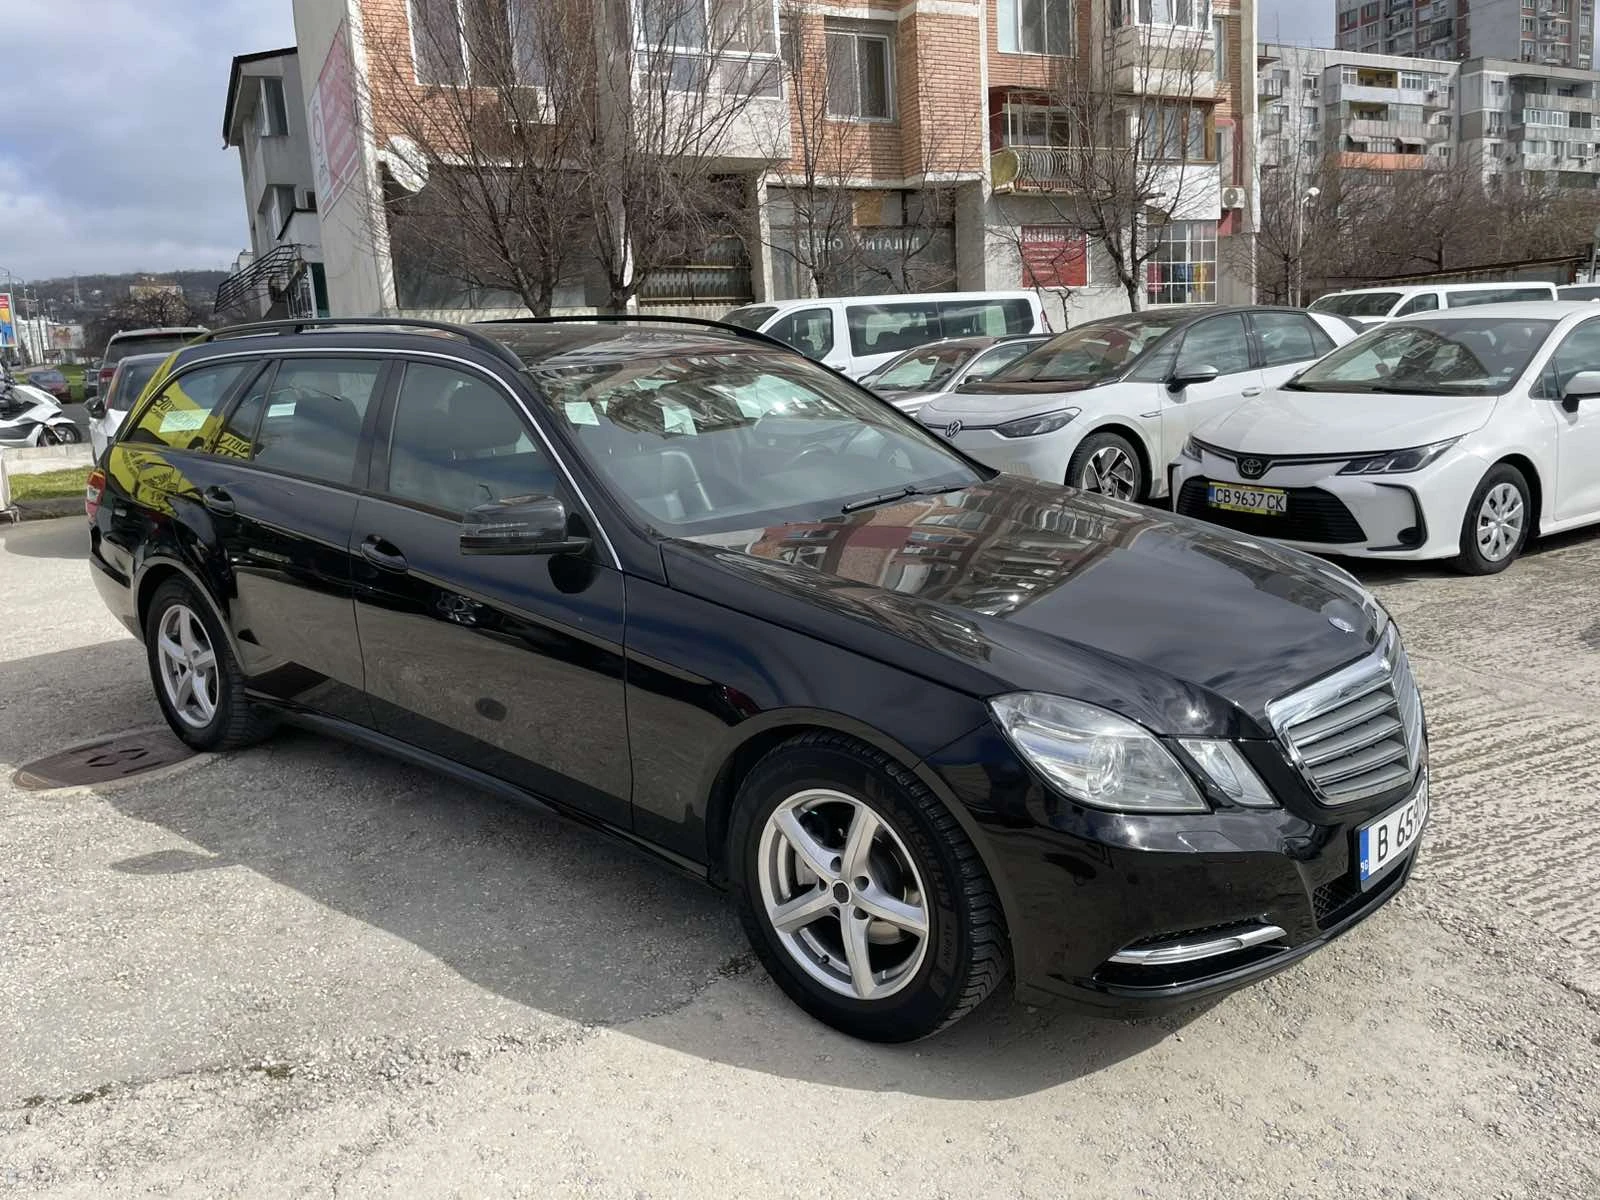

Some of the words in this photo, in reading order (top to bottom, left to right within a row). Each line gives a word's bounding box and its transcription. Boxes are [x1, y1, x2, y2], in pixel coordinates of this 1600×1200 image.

[1216, 488, 1231, 503] CB
[1234, 491, 1264, 507] 9637
[1267, 494, 1284, 510] CK
[1378, 825, 1388, 863] B
